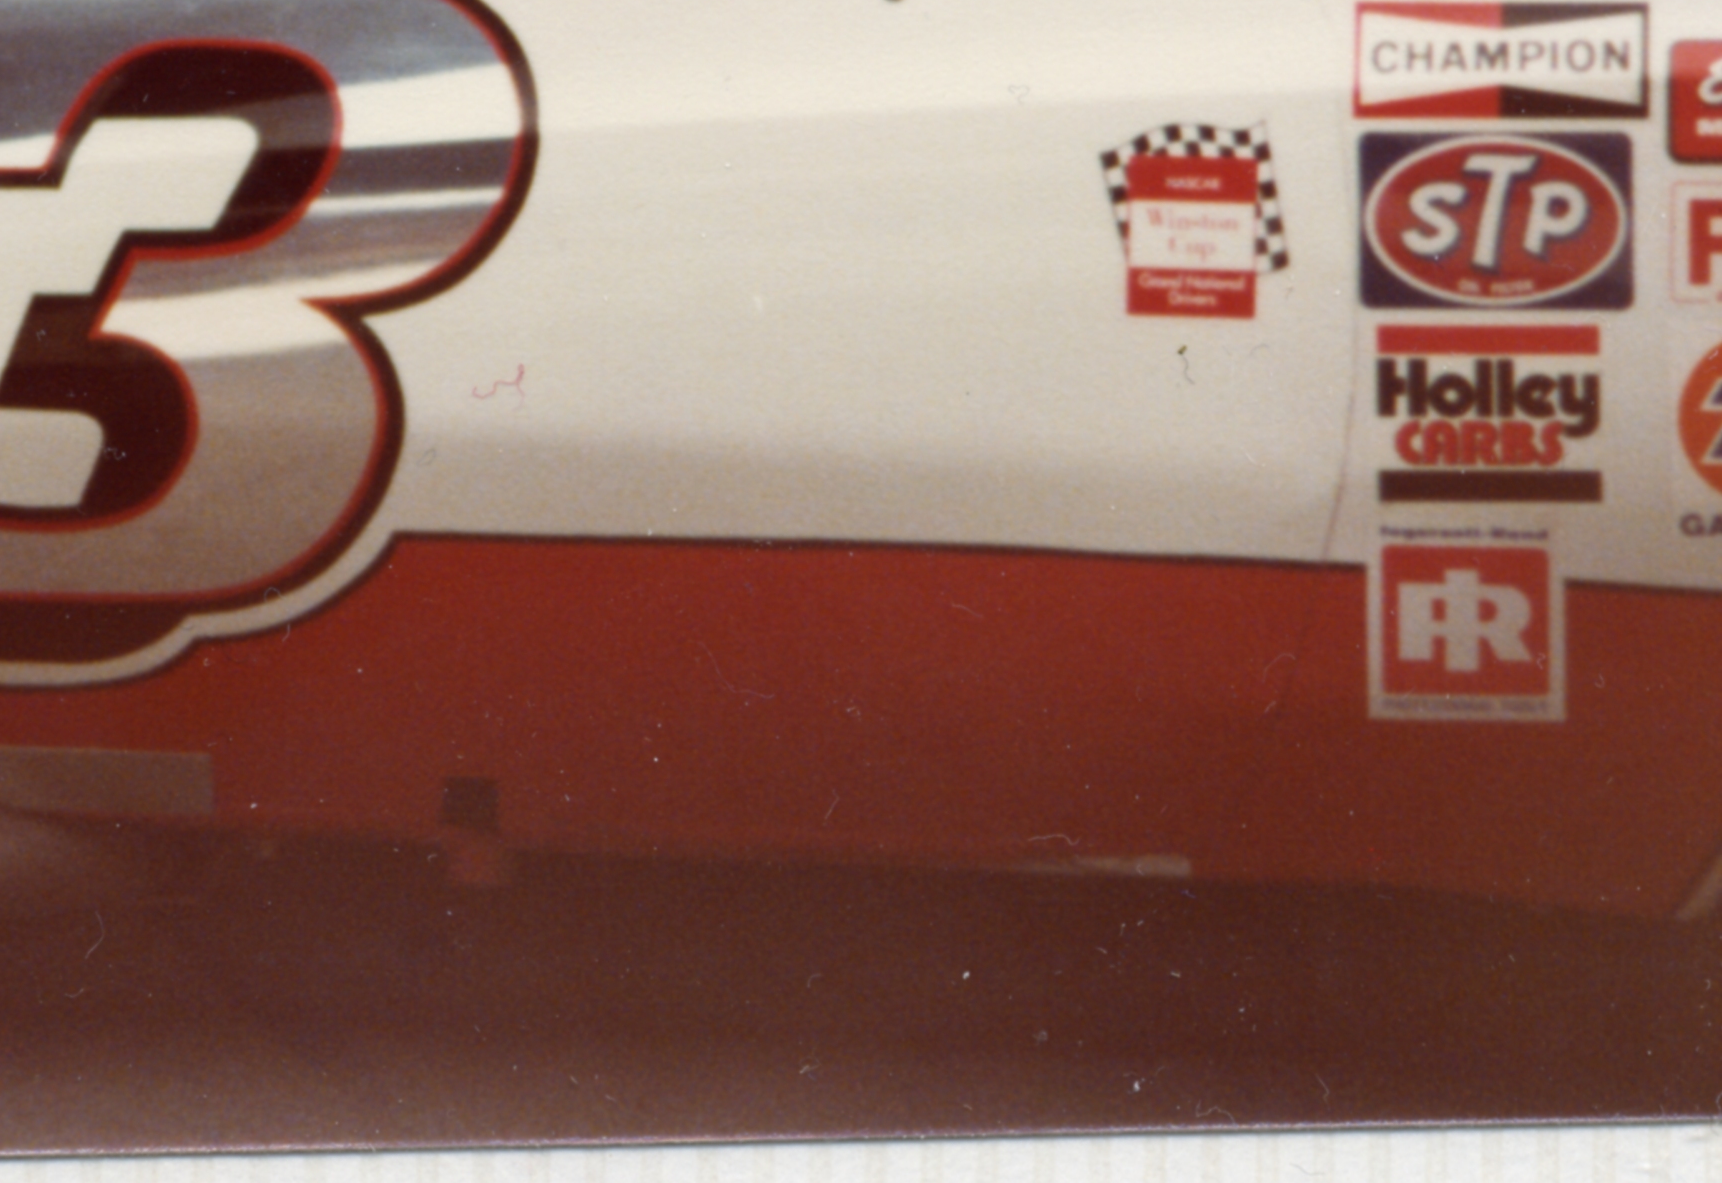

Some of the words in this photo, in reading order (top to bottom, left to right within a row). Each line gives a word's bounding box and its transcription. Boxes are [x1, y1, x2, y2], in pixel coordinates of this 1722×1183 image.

[1371, 40, 1631, 74] CHAMPION
[1165, 176, 1221, 191] NASCAR
[1401, 154, 1587, 269] STP
[1377, 358, 1600, 438] Holley
[1395, 420, 1564, 466] CARBS
